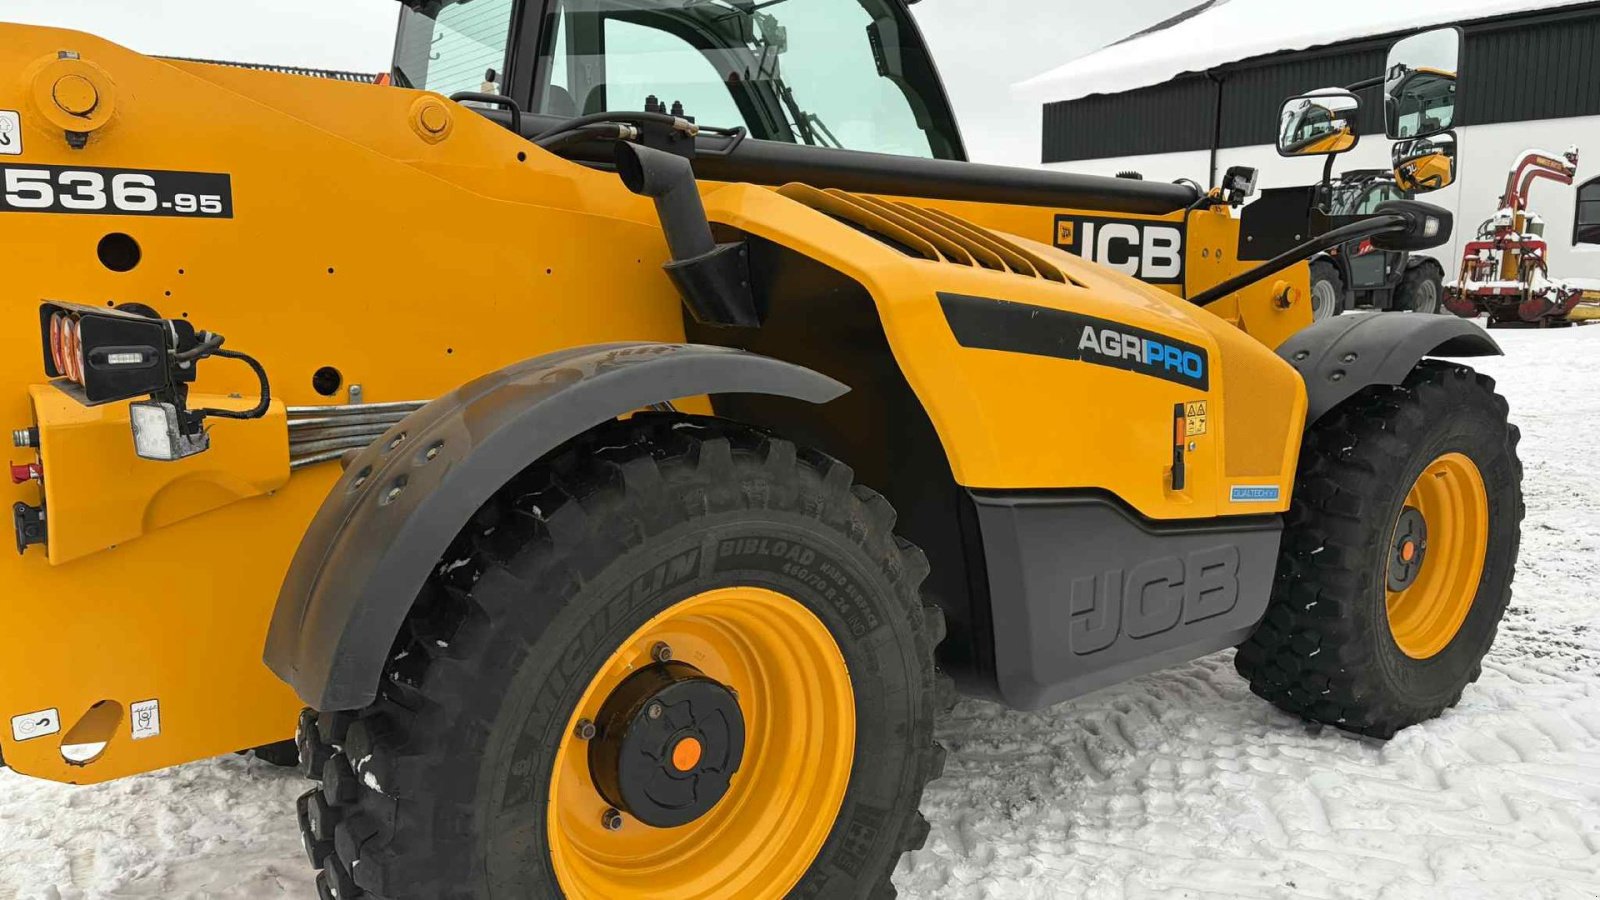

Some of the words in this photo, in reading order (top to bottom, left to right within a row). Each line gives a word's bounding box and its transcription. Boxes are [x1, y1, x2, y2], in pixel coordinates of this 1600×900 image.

[4, 168, 223, 213] 536-95
[1078, 325, 1204, 379] AGRIPRO
[719, 538, 817, 566] BIBLOAD
[819, 561, 847, 586] HARD
[1070, 544, 1240, 656] JCB
[525, 547, 700, 742] MICHELIN
